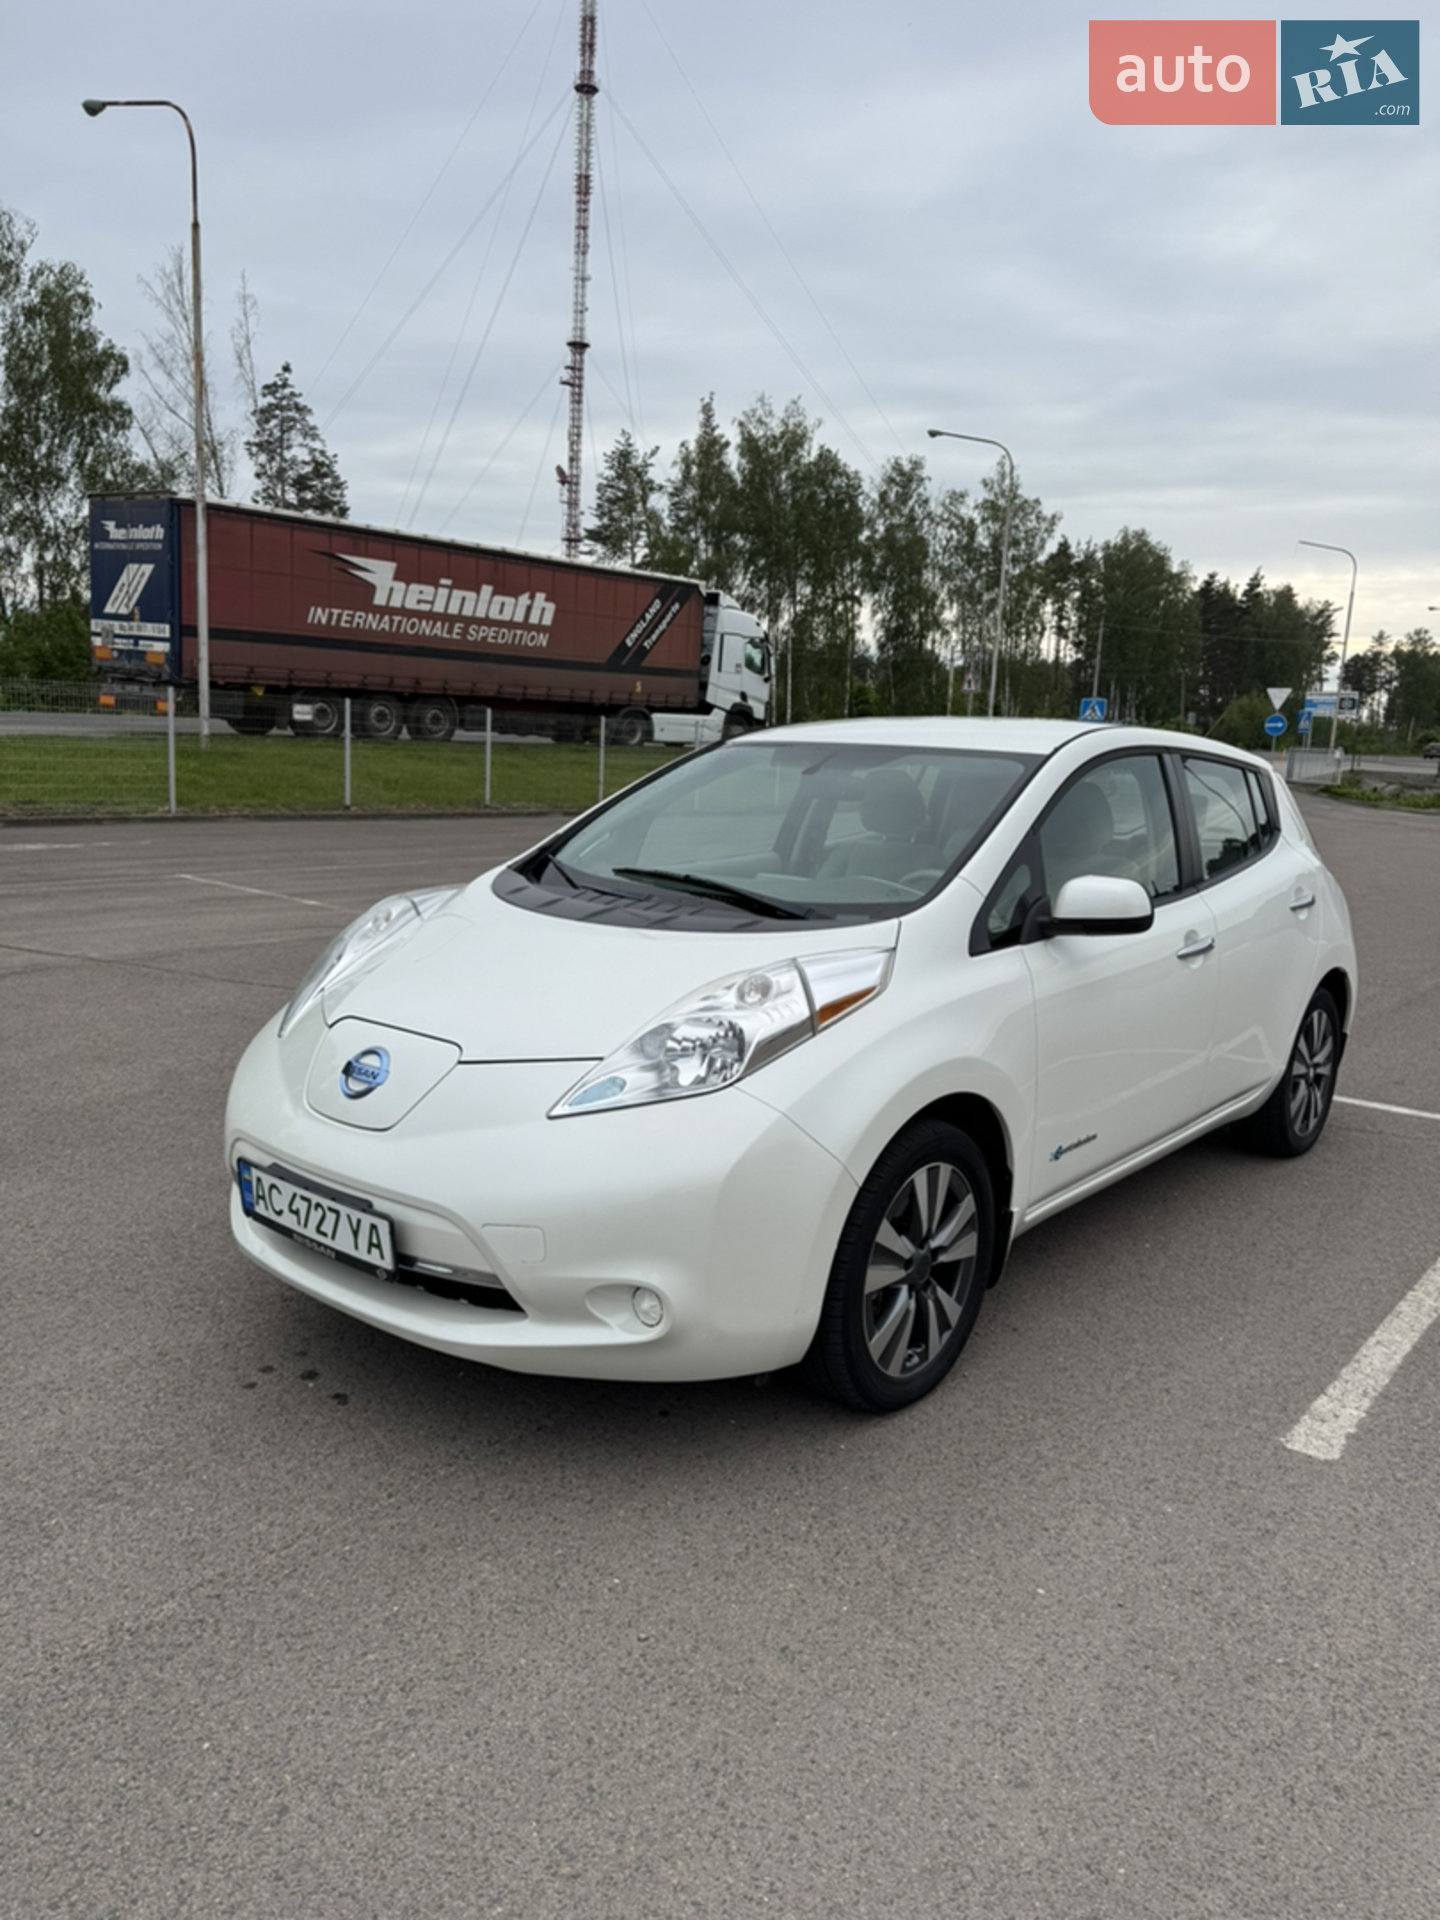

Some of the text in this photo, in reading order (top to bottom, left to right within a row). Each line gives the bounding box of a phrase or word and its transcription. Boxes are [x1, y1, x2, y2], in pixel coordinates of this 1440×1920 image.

[101, 521, 164, 540] heinloth
[335, 553, 556, 626] heinloth
[307, 606, 549, 647] INTERNATIONALE SPEDITION
[625, 598, 662, 648] ENGLAND
[255, 1176, 385, 1261] AC 4727 YA
